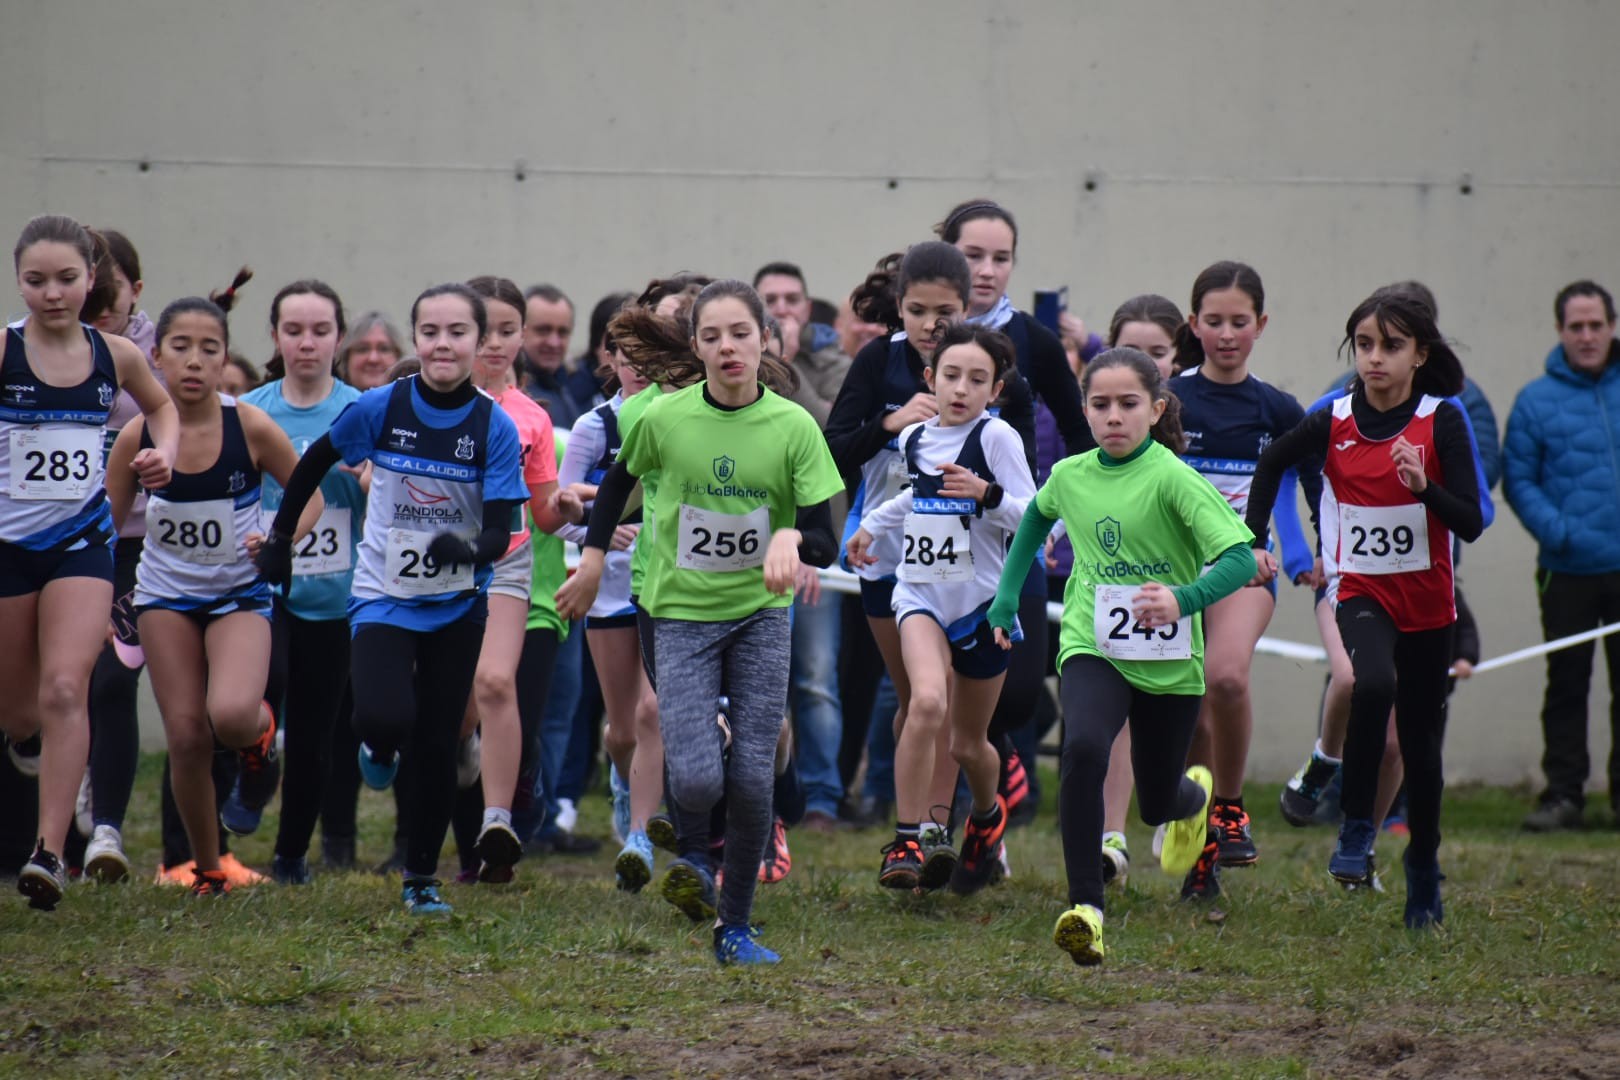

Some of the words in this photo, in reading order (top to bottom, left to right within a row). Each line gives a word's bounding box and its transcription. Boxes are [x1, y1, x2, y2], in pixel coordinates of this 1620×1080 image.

[24, 450, 90, 481] 283
[707, 484, 767, 498] LaBlanca
[394, 503, 463, 517] YANDIOLA
[158, 518, 222, 548] 280
[292, 528, 338, 558] 23
[691, 527, 759, 558] 256
[1351, 525, 1414, 557] 239
[905, 535, 958, 566] 284
[1097, 560, 1172, 578] LaBlanca
[1109, 608, 1179, 641] 245
